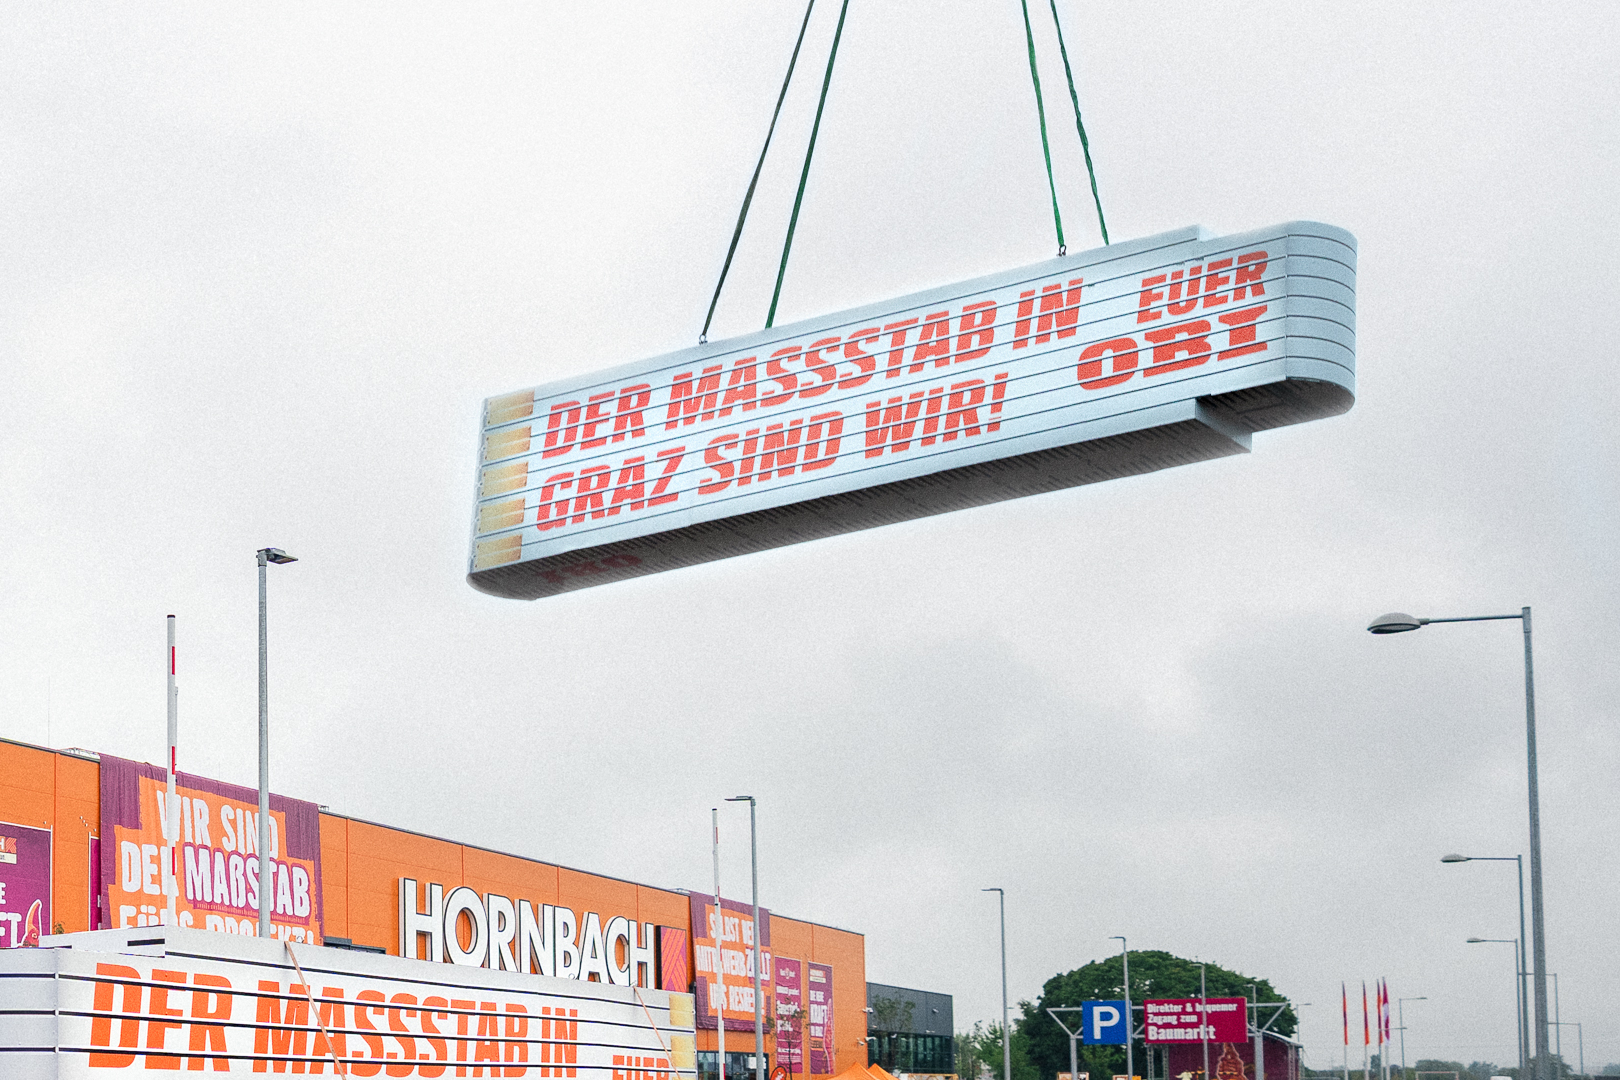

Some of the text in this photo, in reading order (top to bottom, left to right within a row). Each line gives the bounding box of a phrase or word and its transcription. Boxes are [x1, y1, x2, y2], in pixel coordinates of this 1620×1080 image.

[1137, 250, 1268, 323] EUER
[542, 278, 1083, 459] DER MASSSTAB IN
[1077, 305, 1268, 390] OBI
[536, 372, 1008, 531] GRAZ SIND WIR!
[157, 790, 279, 860] WIR SIND
[399, 877, 654, 989] HORNBACH
[709, 912, 739, 942] SLBST
[89, 963, 578, 1078] DER MASSSTAB IN
[1093, 1005, 1120, 1040] P
[1146, 1003, 1183, 1013] Direkter
[1185, 1003, 1193, 1012] &
[1147, 1014, 1198, 1025] Zugang zum
[1147, 1024, 1216, 1040] Baumarkt
